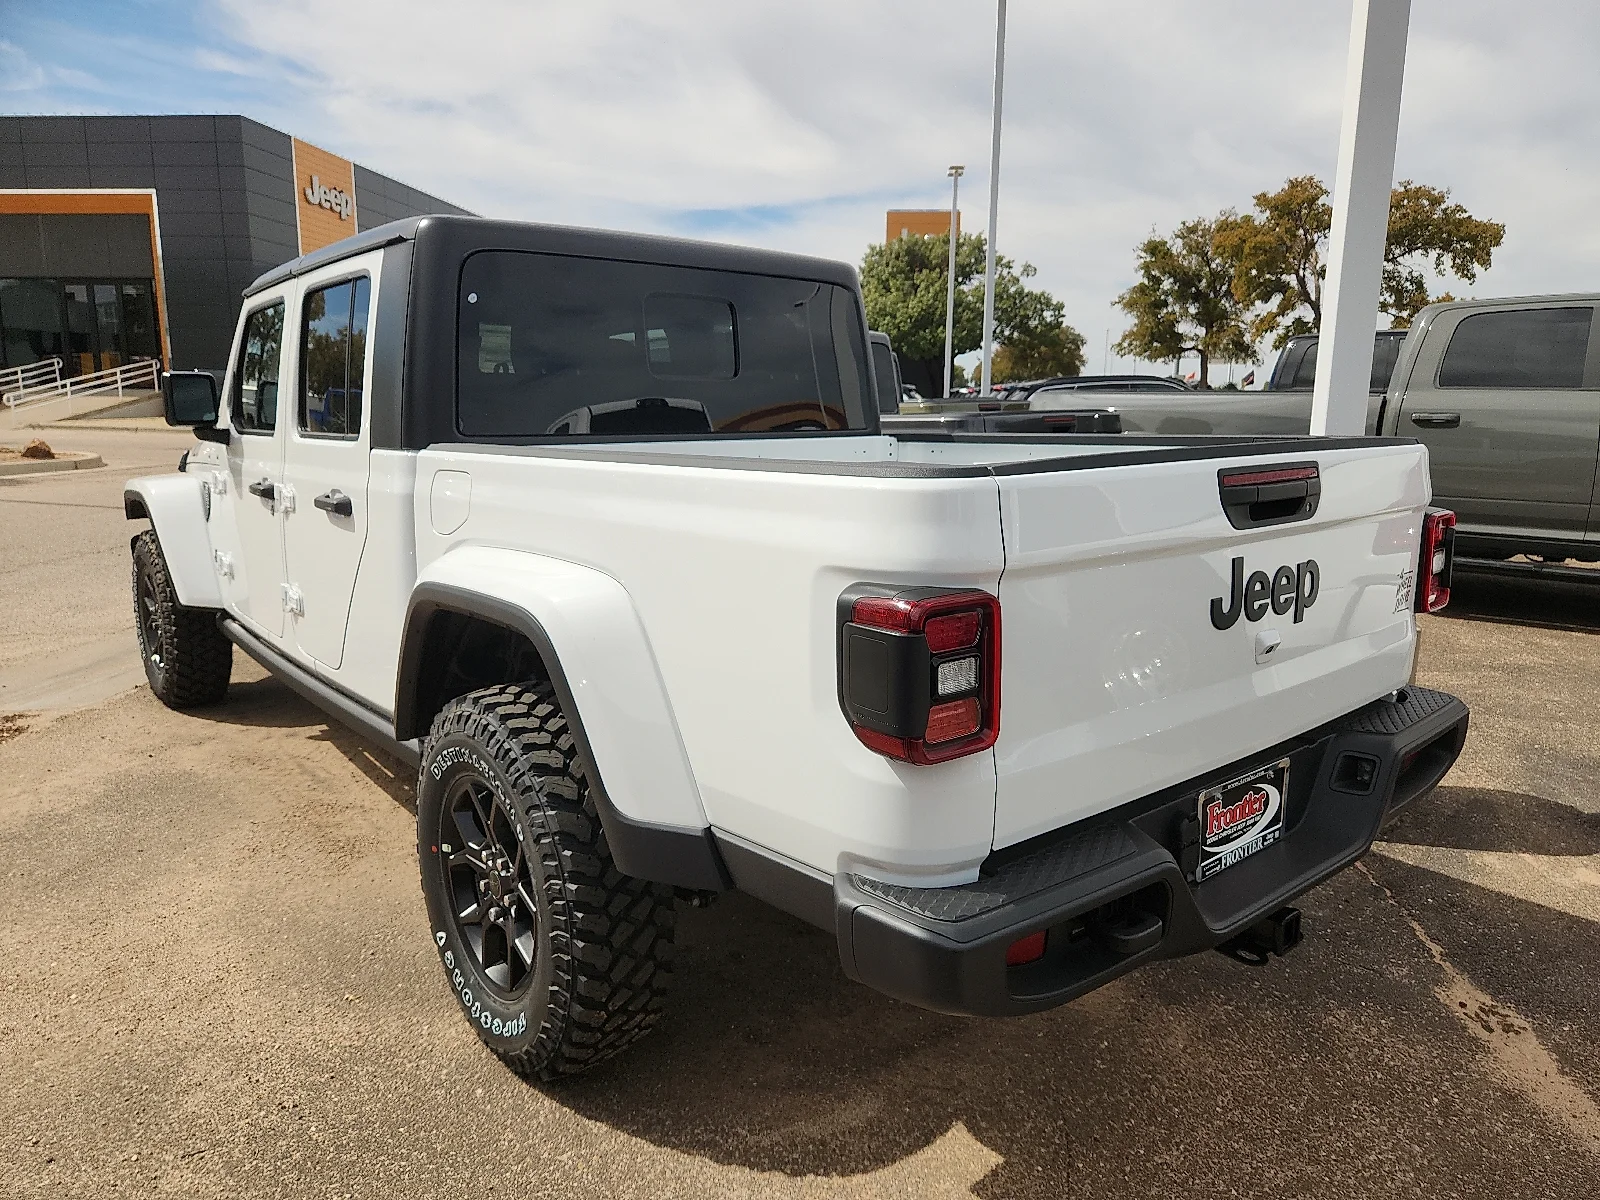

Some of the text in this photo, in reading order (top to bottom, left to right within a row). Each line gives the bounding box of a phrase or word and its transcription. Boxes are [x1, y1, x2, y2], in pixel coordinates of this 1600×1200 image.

[303, 174, 353, 221] Jeep
[1210, 556, 1320, 630] Jeep
[1207, 791, 1266, 837] Frontier
[1221, 837, 1263, 869] FRONTIER
